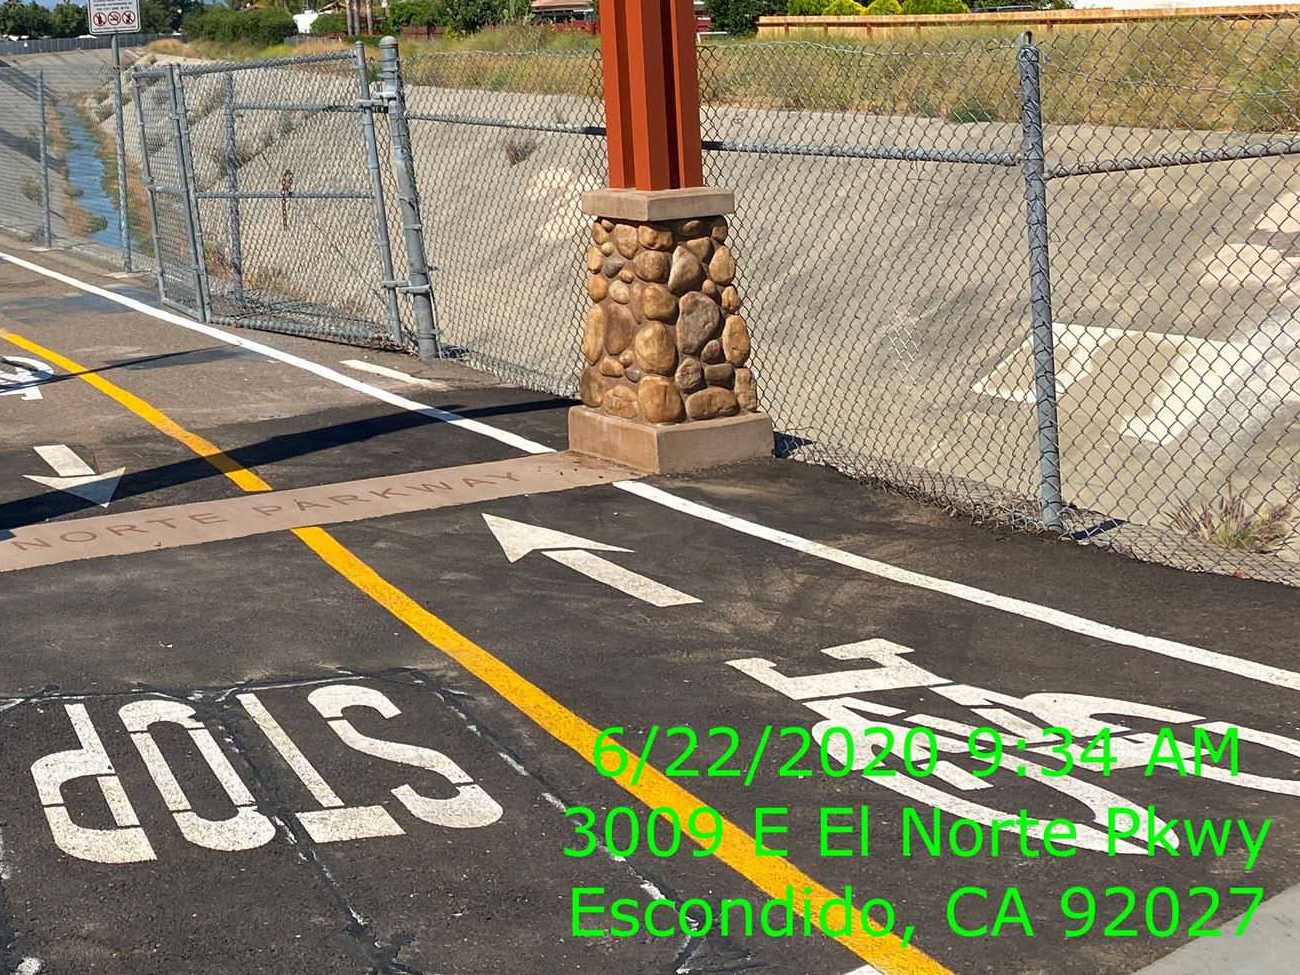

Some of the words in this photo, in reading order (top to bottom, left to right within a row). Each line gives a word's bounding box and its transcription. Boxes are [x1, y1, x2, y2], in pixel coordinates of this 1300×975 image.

[11, 512, 229, 551] NORTE
[252, 471, 521, 516] PARKWAY
[30, 684, 504, 864] STOP
